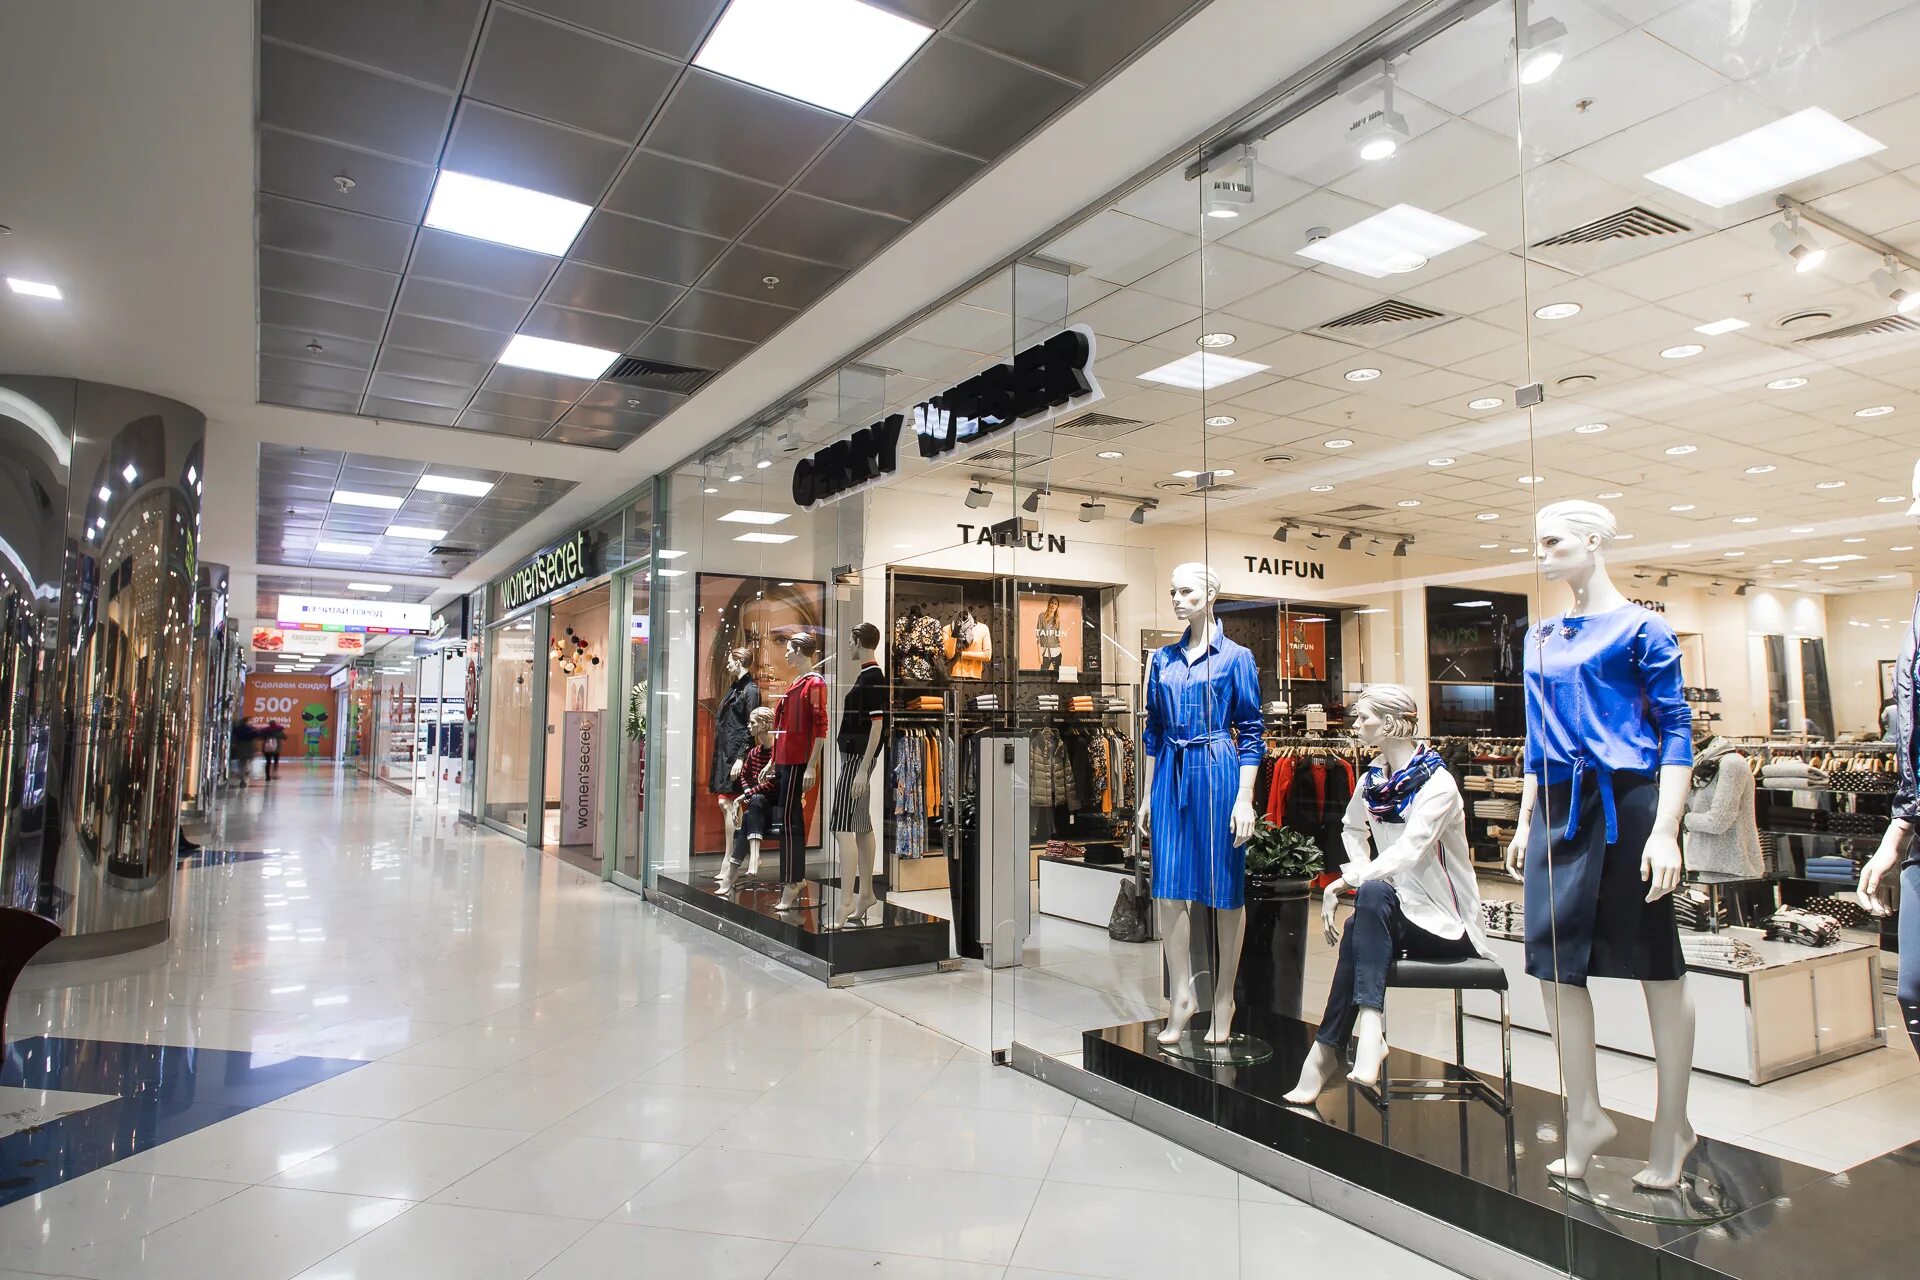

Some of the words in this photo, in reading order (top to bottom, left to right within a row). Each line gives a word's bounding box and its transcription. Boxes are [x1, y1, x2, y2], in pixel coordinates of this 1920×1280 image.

[957, 524, 1066, 554] TAUN
[1244, 556, 1324, 579] TAIFUN
[1036, 629, 1067, 637] TAIFUN
[578, 726, 591, 829] women'secret
